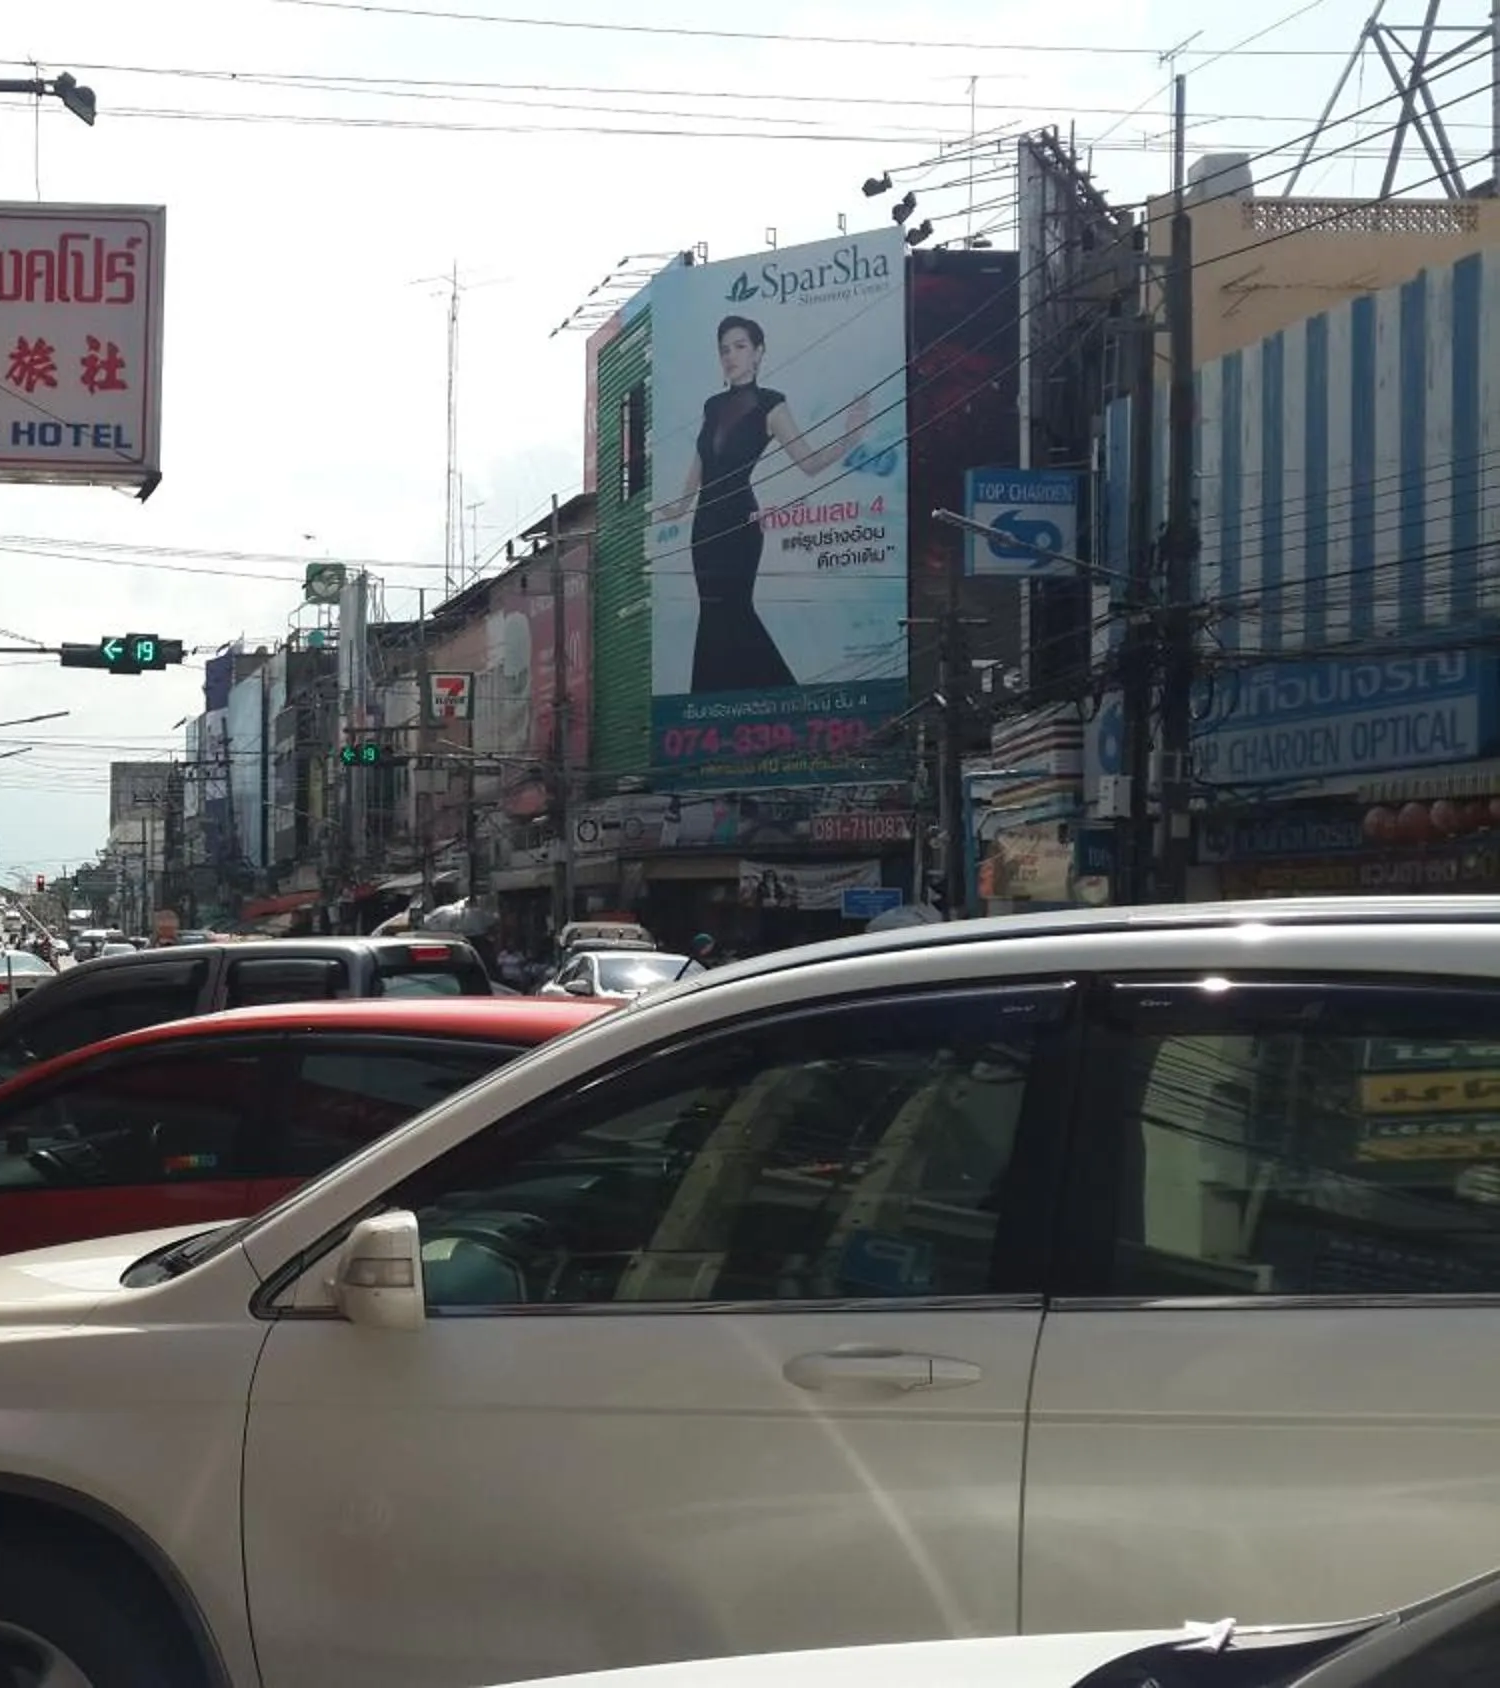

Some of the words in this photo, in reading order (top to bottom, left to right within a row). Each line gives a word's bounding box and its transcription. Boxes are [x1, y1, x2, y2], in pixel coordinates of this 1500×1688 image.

[761, 245, 890, 304] SparSha
[11, 421, 133, 450] HOTEL
[137, 641, 153, 661] 19
[1352, 709, 1468, 761] OPTICAL
[363, 747, 375, 761] 19
